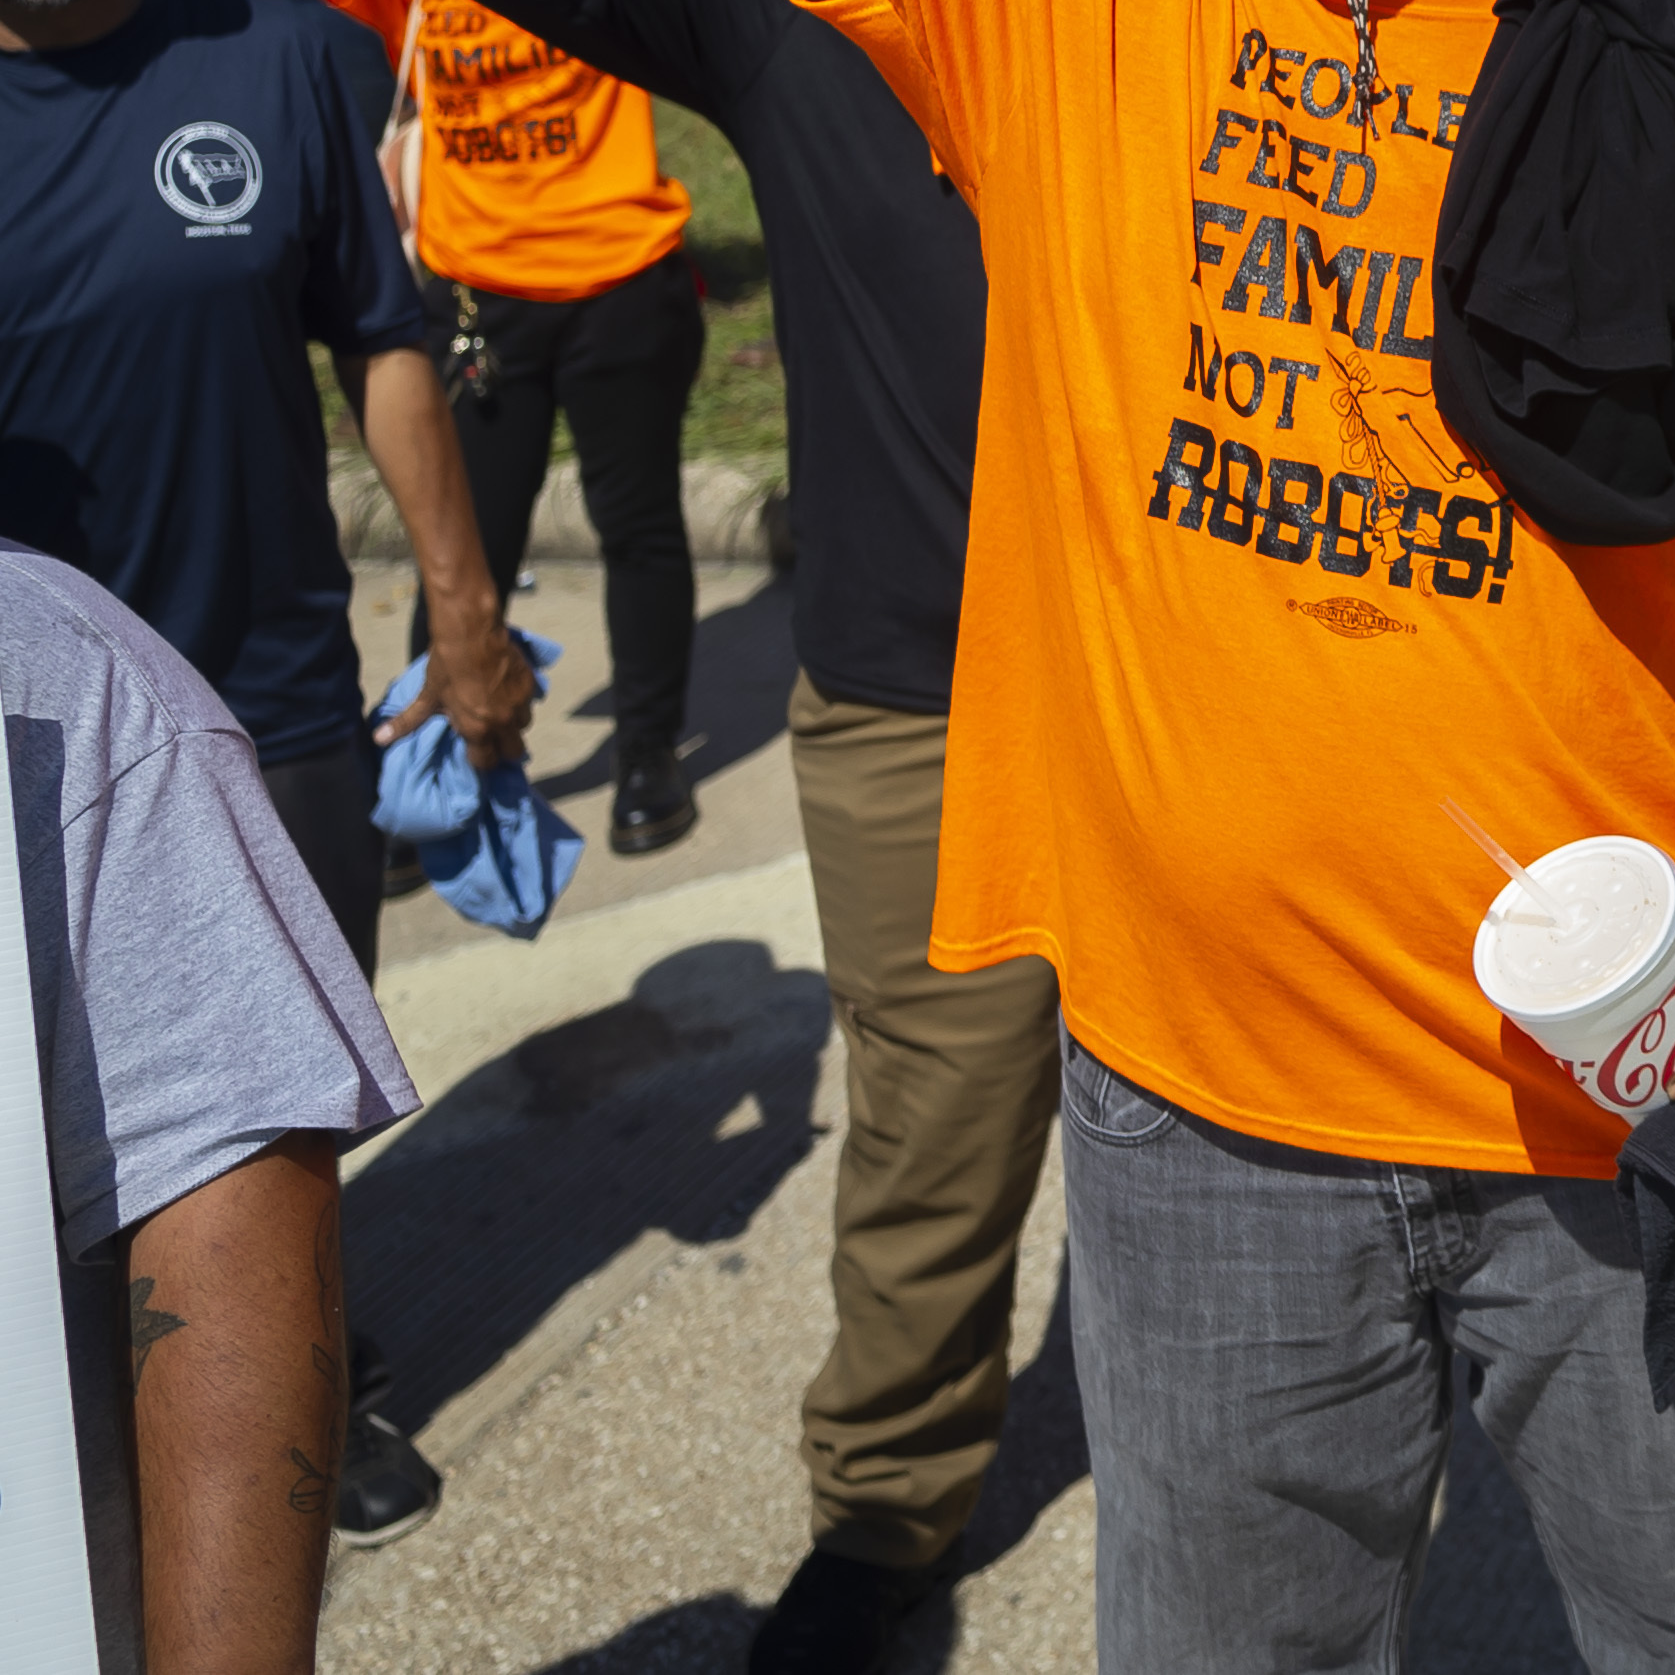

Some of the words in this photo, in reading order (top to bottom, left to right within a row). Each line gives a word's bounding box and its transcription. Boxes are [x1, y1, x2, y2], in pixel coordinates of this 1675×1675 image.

[1199, 108, 1378, 218] FEED
[1190, 198, 1434, 361] FAMIL
[1183, 321, 1321, 431] NOT
[1147, 416, 1514, 605] ROBOTS!
